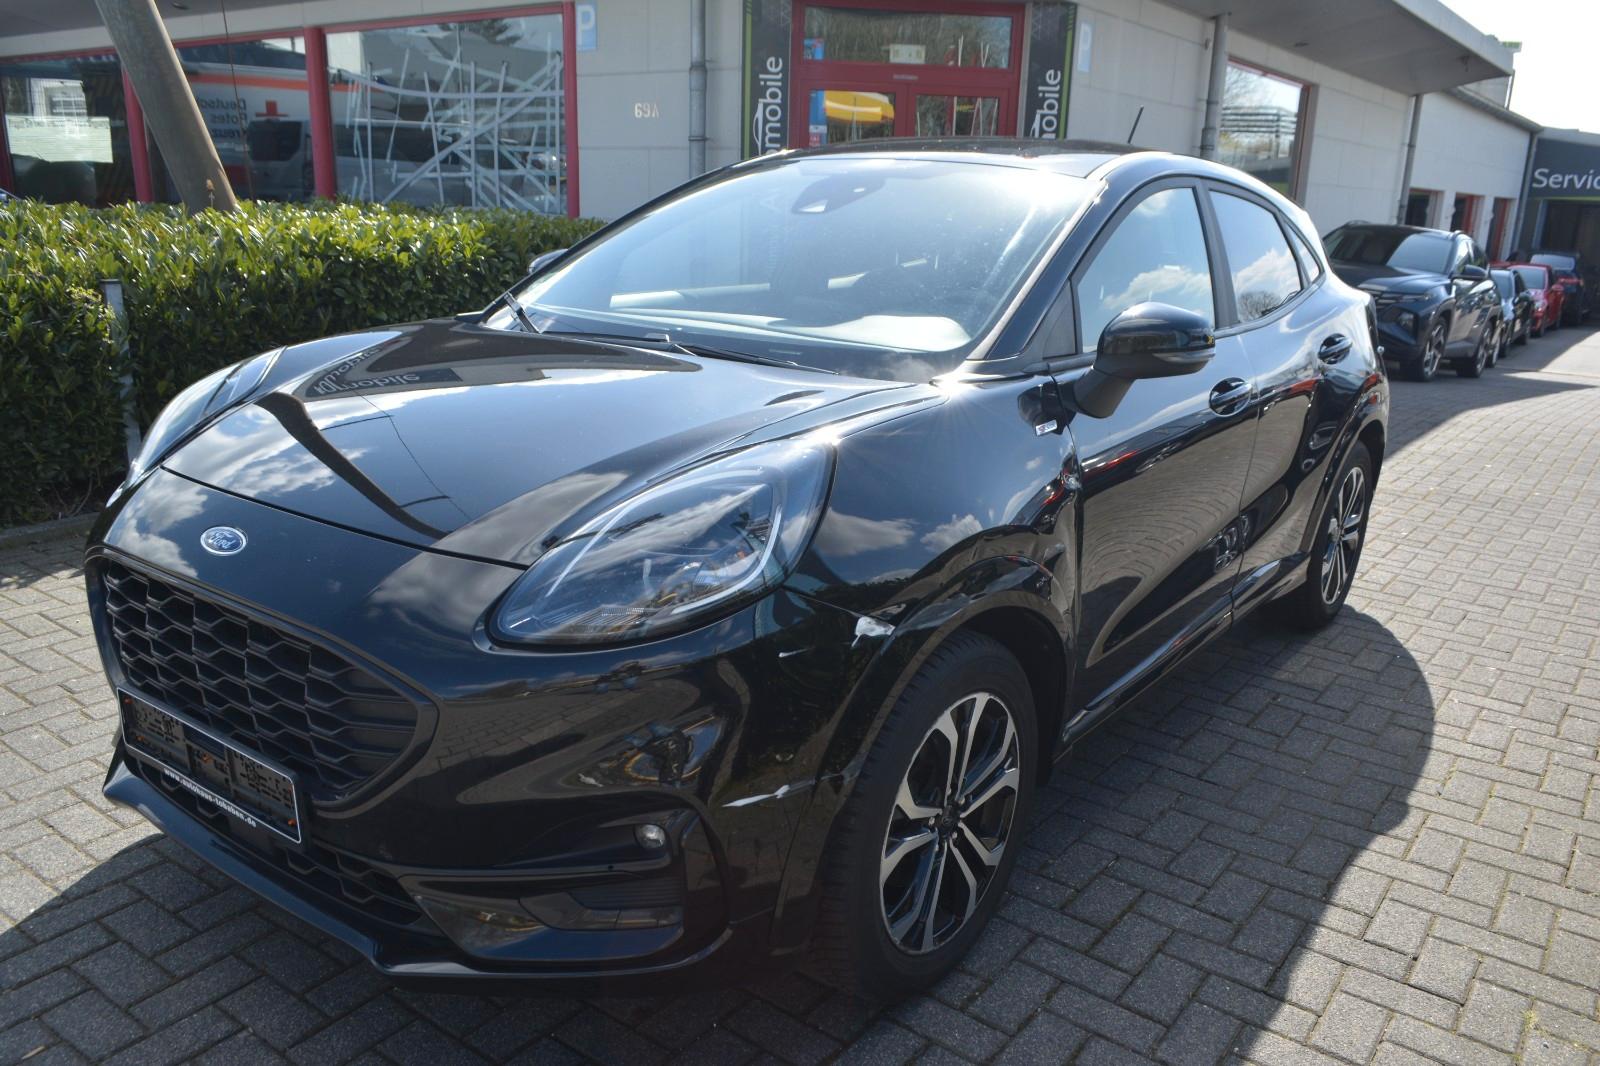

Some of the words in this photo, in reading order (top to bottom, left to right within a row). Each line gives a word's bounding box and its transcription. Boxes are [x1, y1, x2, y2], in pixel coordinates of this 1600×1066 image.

[634, 102, 659, 119] 69A
[1037, 68, 1062, 138] obile
[208, 529, 237, 550] Ford
